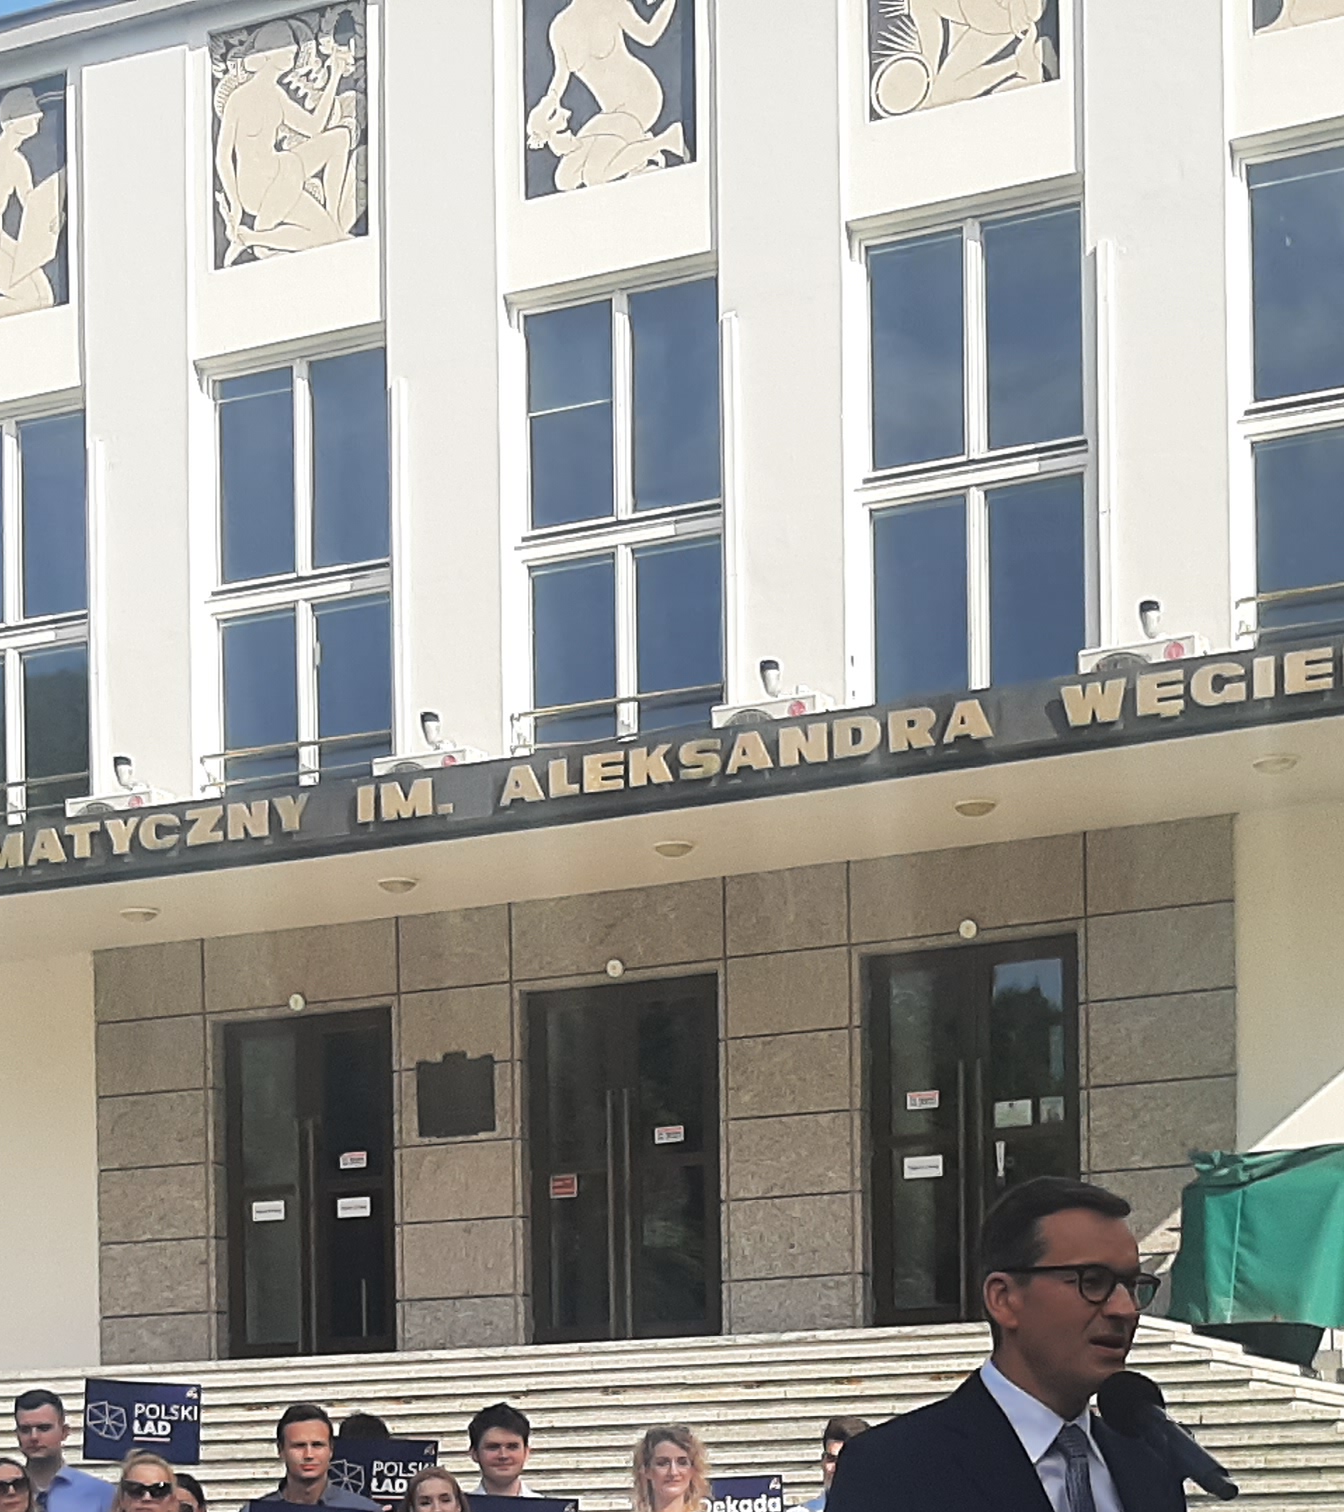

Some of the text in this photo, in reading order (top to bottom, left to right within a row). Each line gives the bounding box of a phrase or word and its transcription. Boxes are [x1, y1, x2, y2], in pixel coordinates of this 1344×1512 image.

[356, 778, 454, 825] IM.
[499, 698, 994, 807] ALEKSANDRA
[134, 1403, 198, 1421] POLSKI
[132, 1419, 172, 1436] ŁAD
[371, 1460, 435, 1478] POLSK
[370, 1476, 408, 1494] ŁAD
